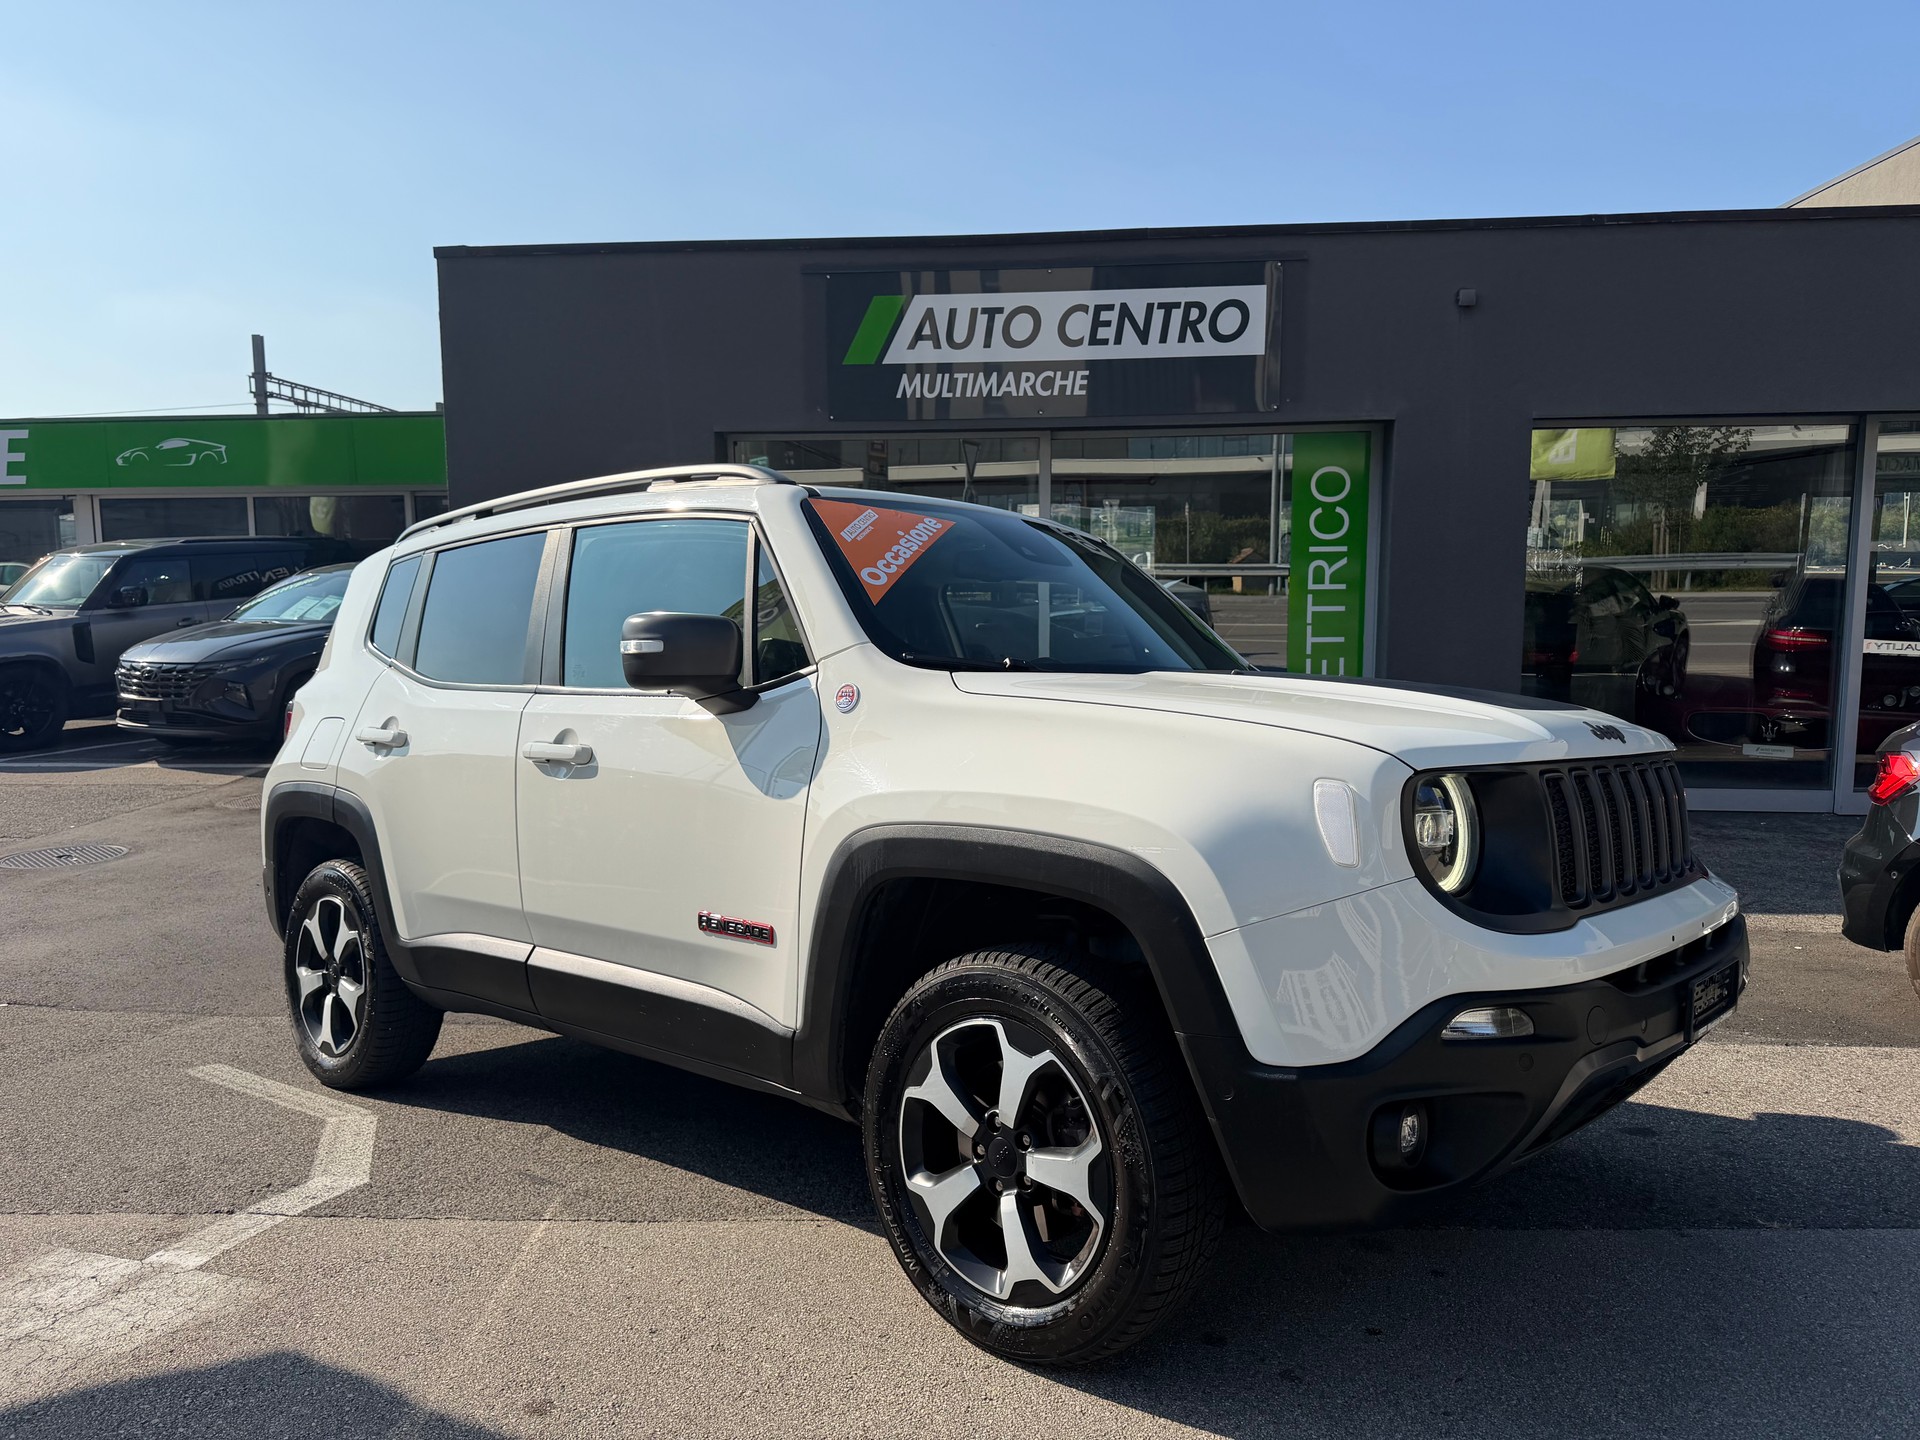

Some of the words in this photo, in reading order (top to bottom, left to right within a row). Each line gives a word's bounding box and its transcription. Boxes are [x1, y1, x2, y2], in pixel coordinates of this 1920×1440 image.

[907, 305, 1042, 350] AUTO
[1057, 298, 1250, 347] CENTRO
[896, 370, 1089, 398] MULTIMARCHE
[860, 517, 943, 586] Occasione
[698, 911, 774, 944] RENEGADE
